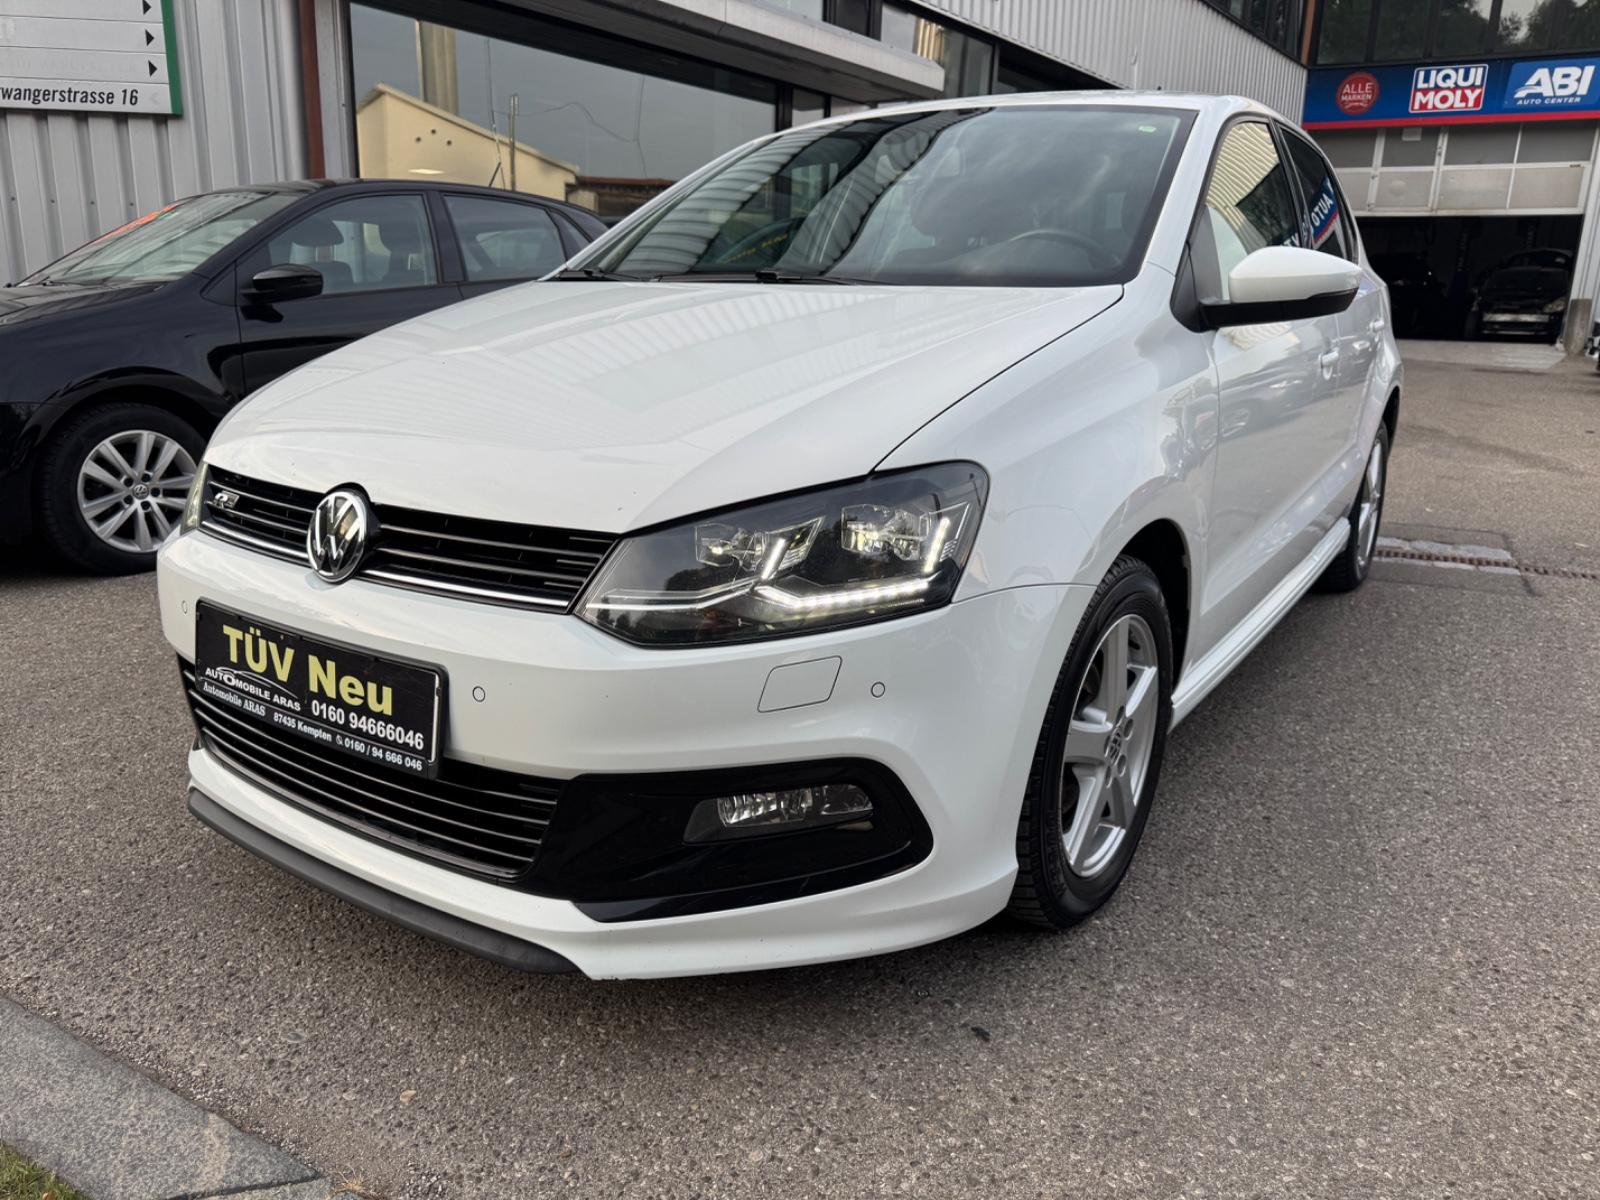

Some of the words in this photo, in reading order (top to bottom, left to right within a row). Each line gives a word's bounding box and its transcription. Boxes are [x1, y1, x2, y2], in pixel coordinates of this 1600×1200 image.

[1342, 82, 1374, 94] ALLE
[1416, 67, 1484, 89] LIQUI
[1513, 65, 1596, 98] ABI
[0, 86, 115, 105] wangerstrasse
[121, 89, 139, 106] 16
[1413, 87, 1483, 110] MOLY
[1544, 96, 1582, 104] CENTER
[222, 624, 295, 683] TÜV
[308, 654, 393, 716] Neu
[203, 681, 242, 707] Automobile
[242, 699, 266, 717] ARAS
[205, 667, 271, 700] AUTOMOBILE
[272, 694, 301, 711] ARAS
[273, 712, 296, 729] 87435
[297, 720, 332, 742] Kempten
[311, 700, 345, 725] 0160
[349, 712, 424, 750] 94666046
[344, 737, 365, 753] 0160
[372, 746, 383, 759] 94
[385, 752, 403, 765] 666
[404, 758, 423, 772] 046
